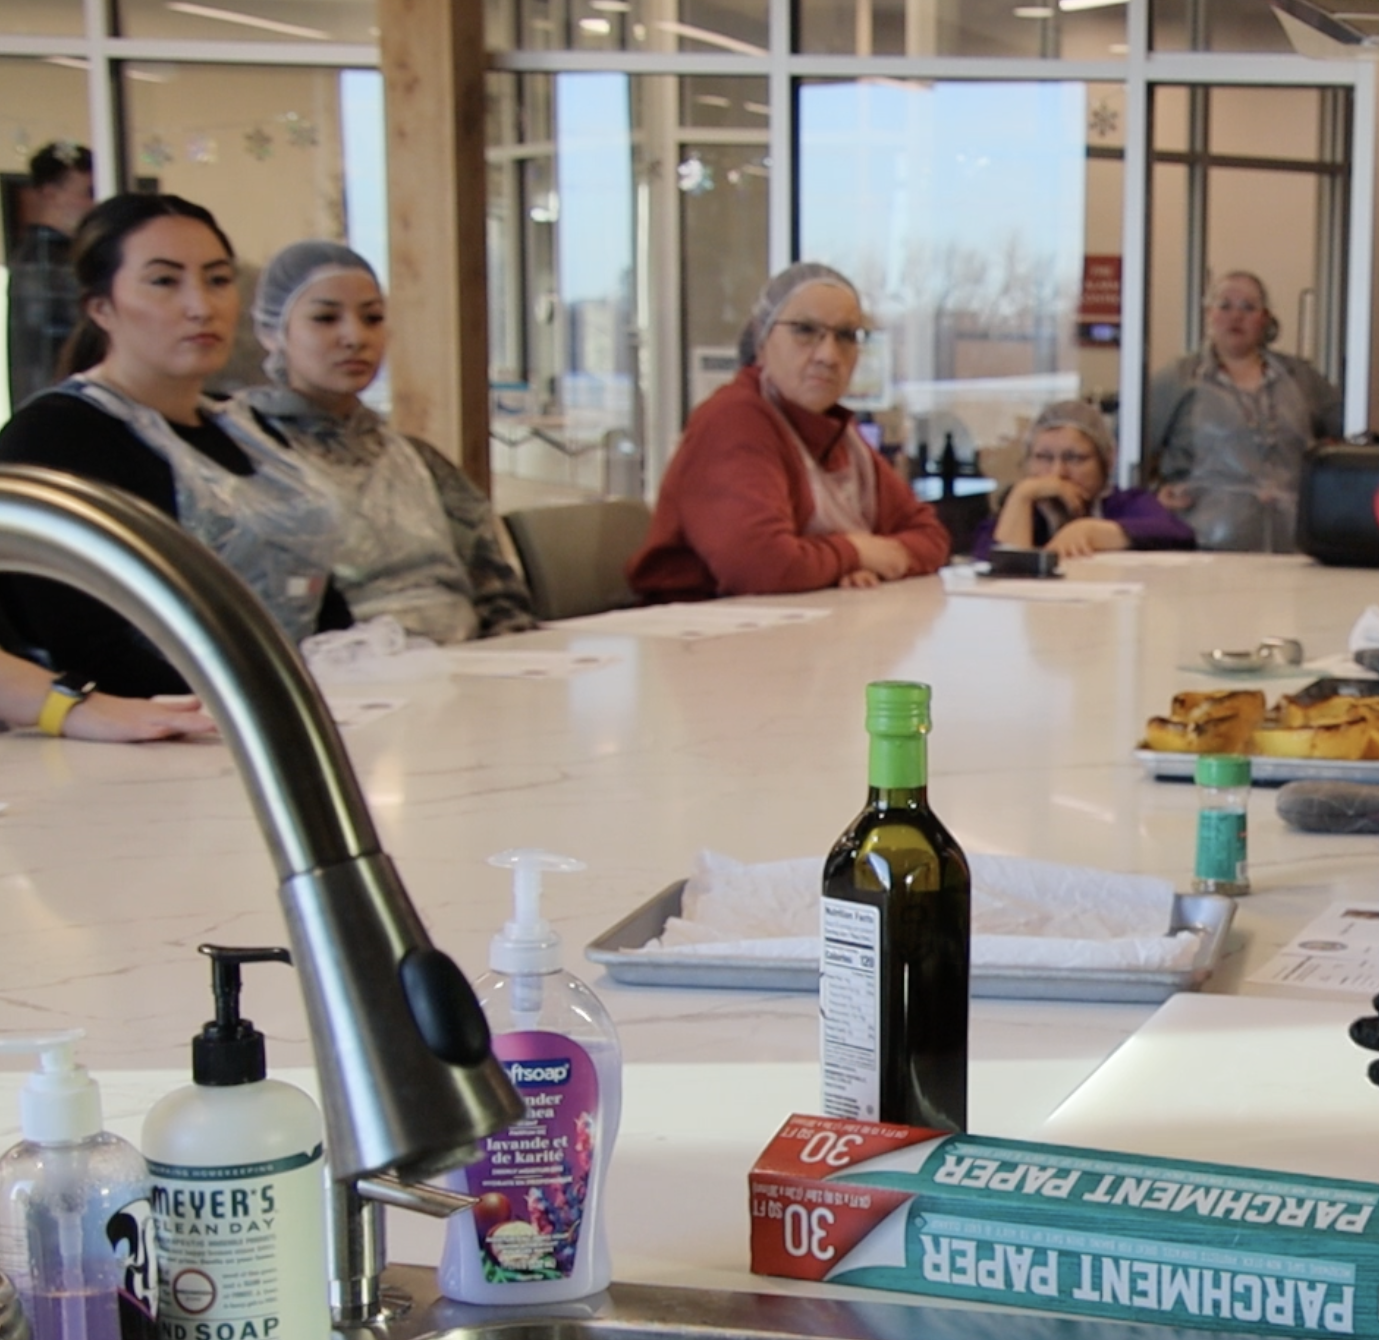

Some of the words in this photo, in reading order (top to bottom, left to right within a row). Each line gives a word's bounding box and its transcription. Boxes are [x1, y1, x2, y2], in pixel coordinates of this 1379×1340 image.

[506, 1063, 567, 1086] ftsoap
[524, 1093, 563, 1106] nder
[486, 1137, 550, 1151] lavande
[552, 1136, 569, 1148] et
[780, 1127, 796, 1138] FT
[797, 1128, 815, 1139] SQ
[491, 1152, 512, 1164] de
[514, 1149, 564, 1163] karité
[799, 1131, 863, 1166] 30
[933, 1155, 1082, 1198] PAPER
[151, 1184, 275, 1219] MEYER'S
[752, 1199, 767, 1217] FT
[767, 1199, 783, 1219] SQ
[1082, 1174, 1374, 1233] PARCHMENT
[229, 1217, 275, 1235] DAY
[784, 1204, 835, 1260] 30
[920, 1234, 1059, 1297] PAPER
[1072, 1253, 1355, 1334] PARCHMENT
[159, 1322, 187, 1340] ND
[195, 1316, 279, 1340] SOAP
